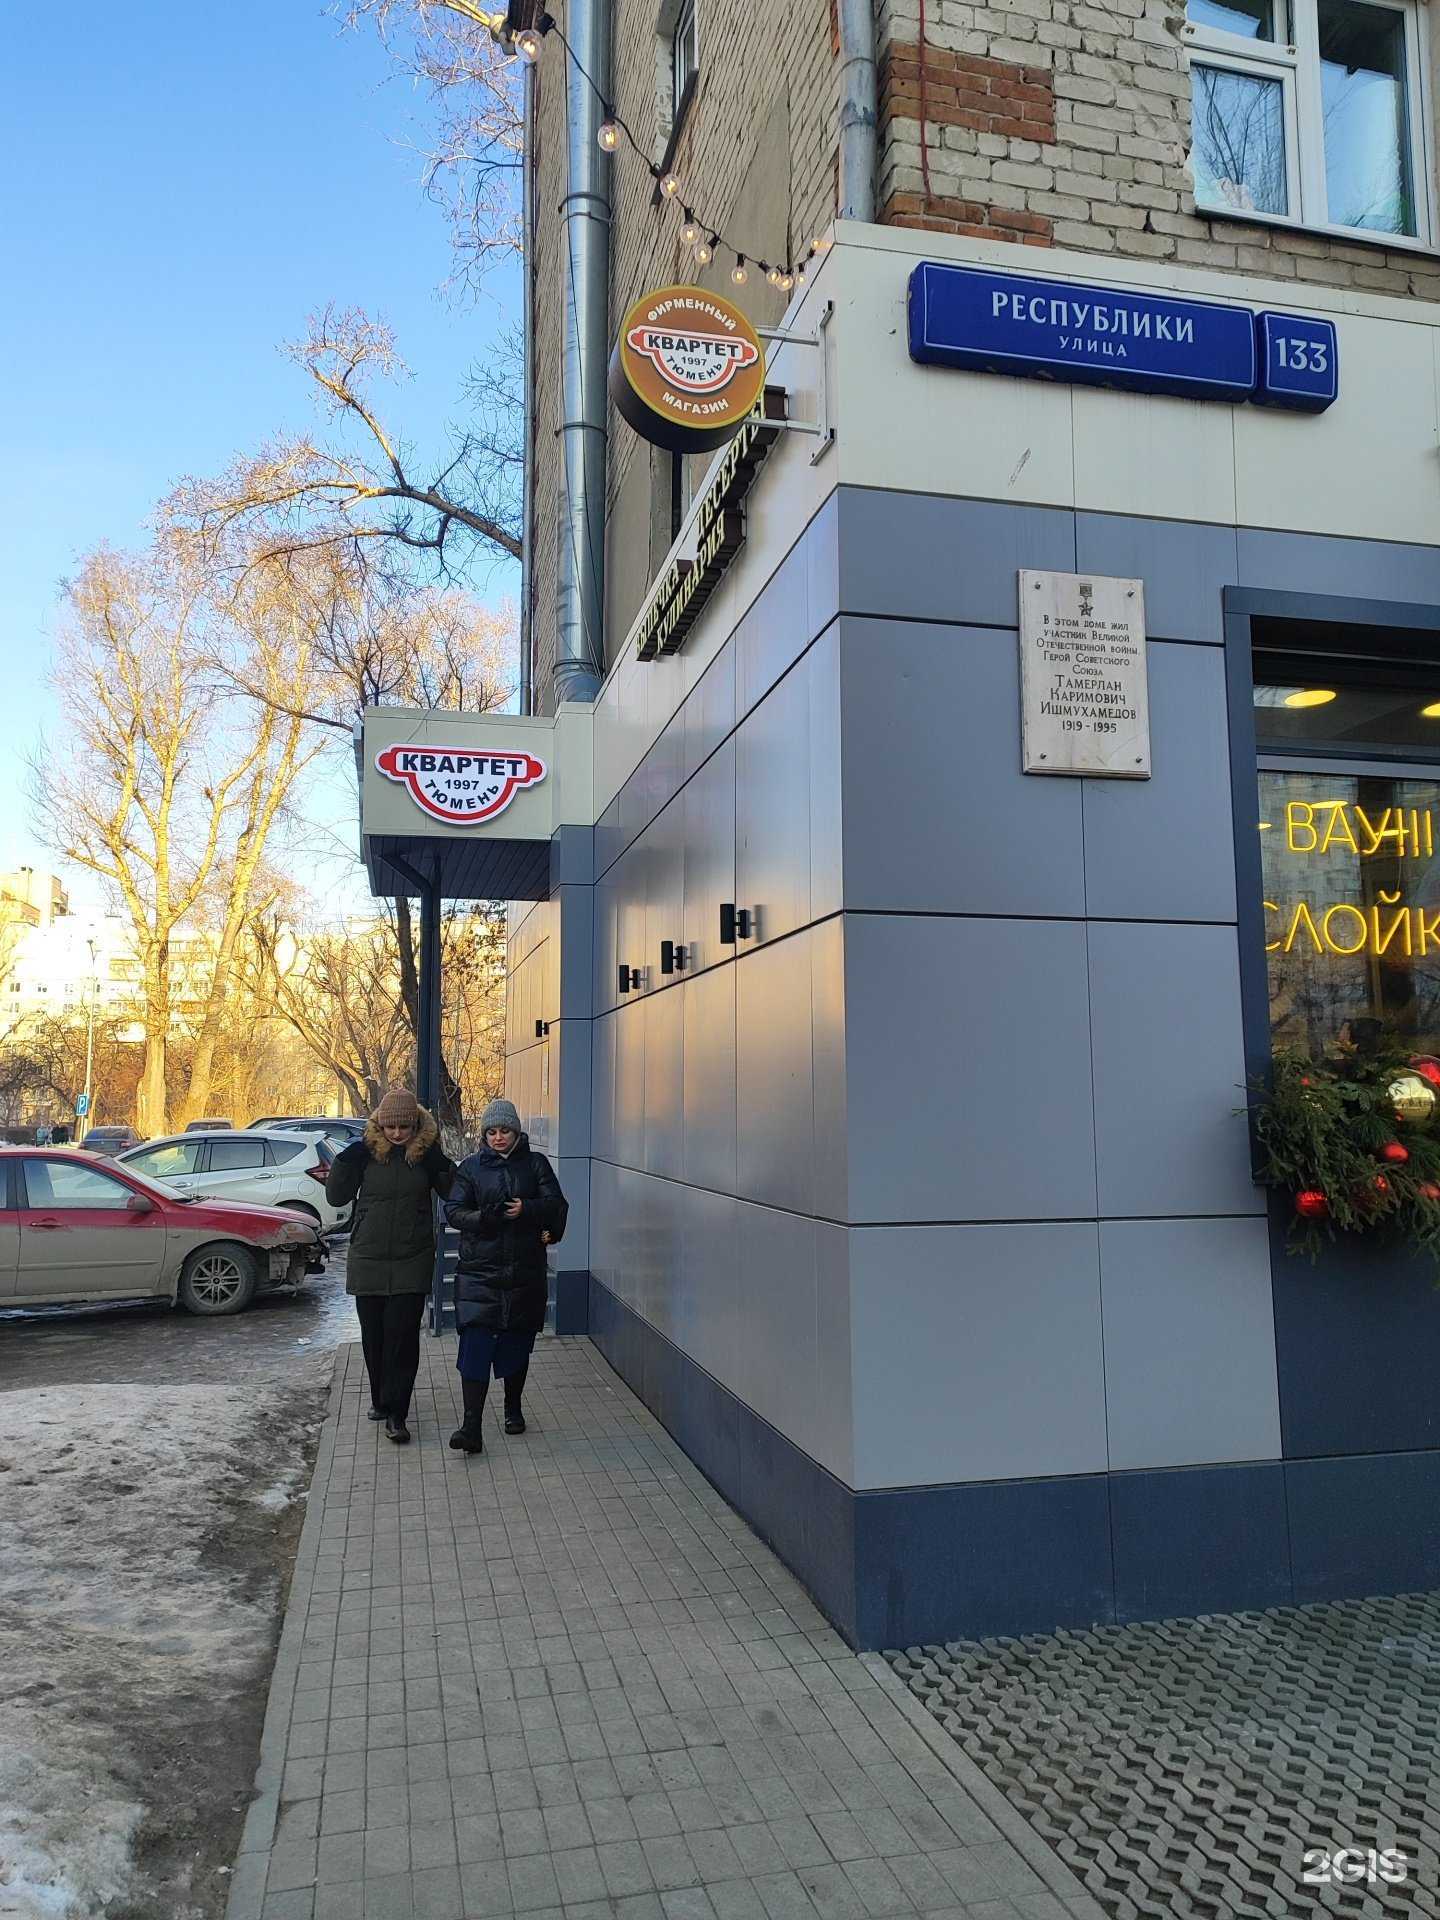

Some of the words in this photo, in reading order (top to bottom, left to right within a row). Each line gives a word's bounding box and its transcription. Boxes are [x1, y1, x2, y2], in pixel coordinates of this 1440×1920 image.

[647, 298, 737, 331] ФИРМЕННЫЙ
[992, 291, 1194, 344] РЕСПУБЛИКИ
[648, 335, 739, 358] КВАРТЕТ
[1059, 335, 1128, 358] УЛИЦА
[1275, 336, 1328, 374] 133
[666, 356, 722, 381] ТЮМЕНЬ
[681, 356, 707, 366] 1997
[662, 392, 729, 414] МАГАЗИН
[657, 508, 725, 655] КУЛИНАРИЯ
[1043, 615, 1050, 625] В
[1062, 720, 1083, 732] 1919
[1094, 721, 1117, 733] 1995
[402, 753, 523, 777] КВАРТЕТ
[425, 779, 500, 810] ТЮМЕНЬ
[445, 779, 480, 791] 1997
